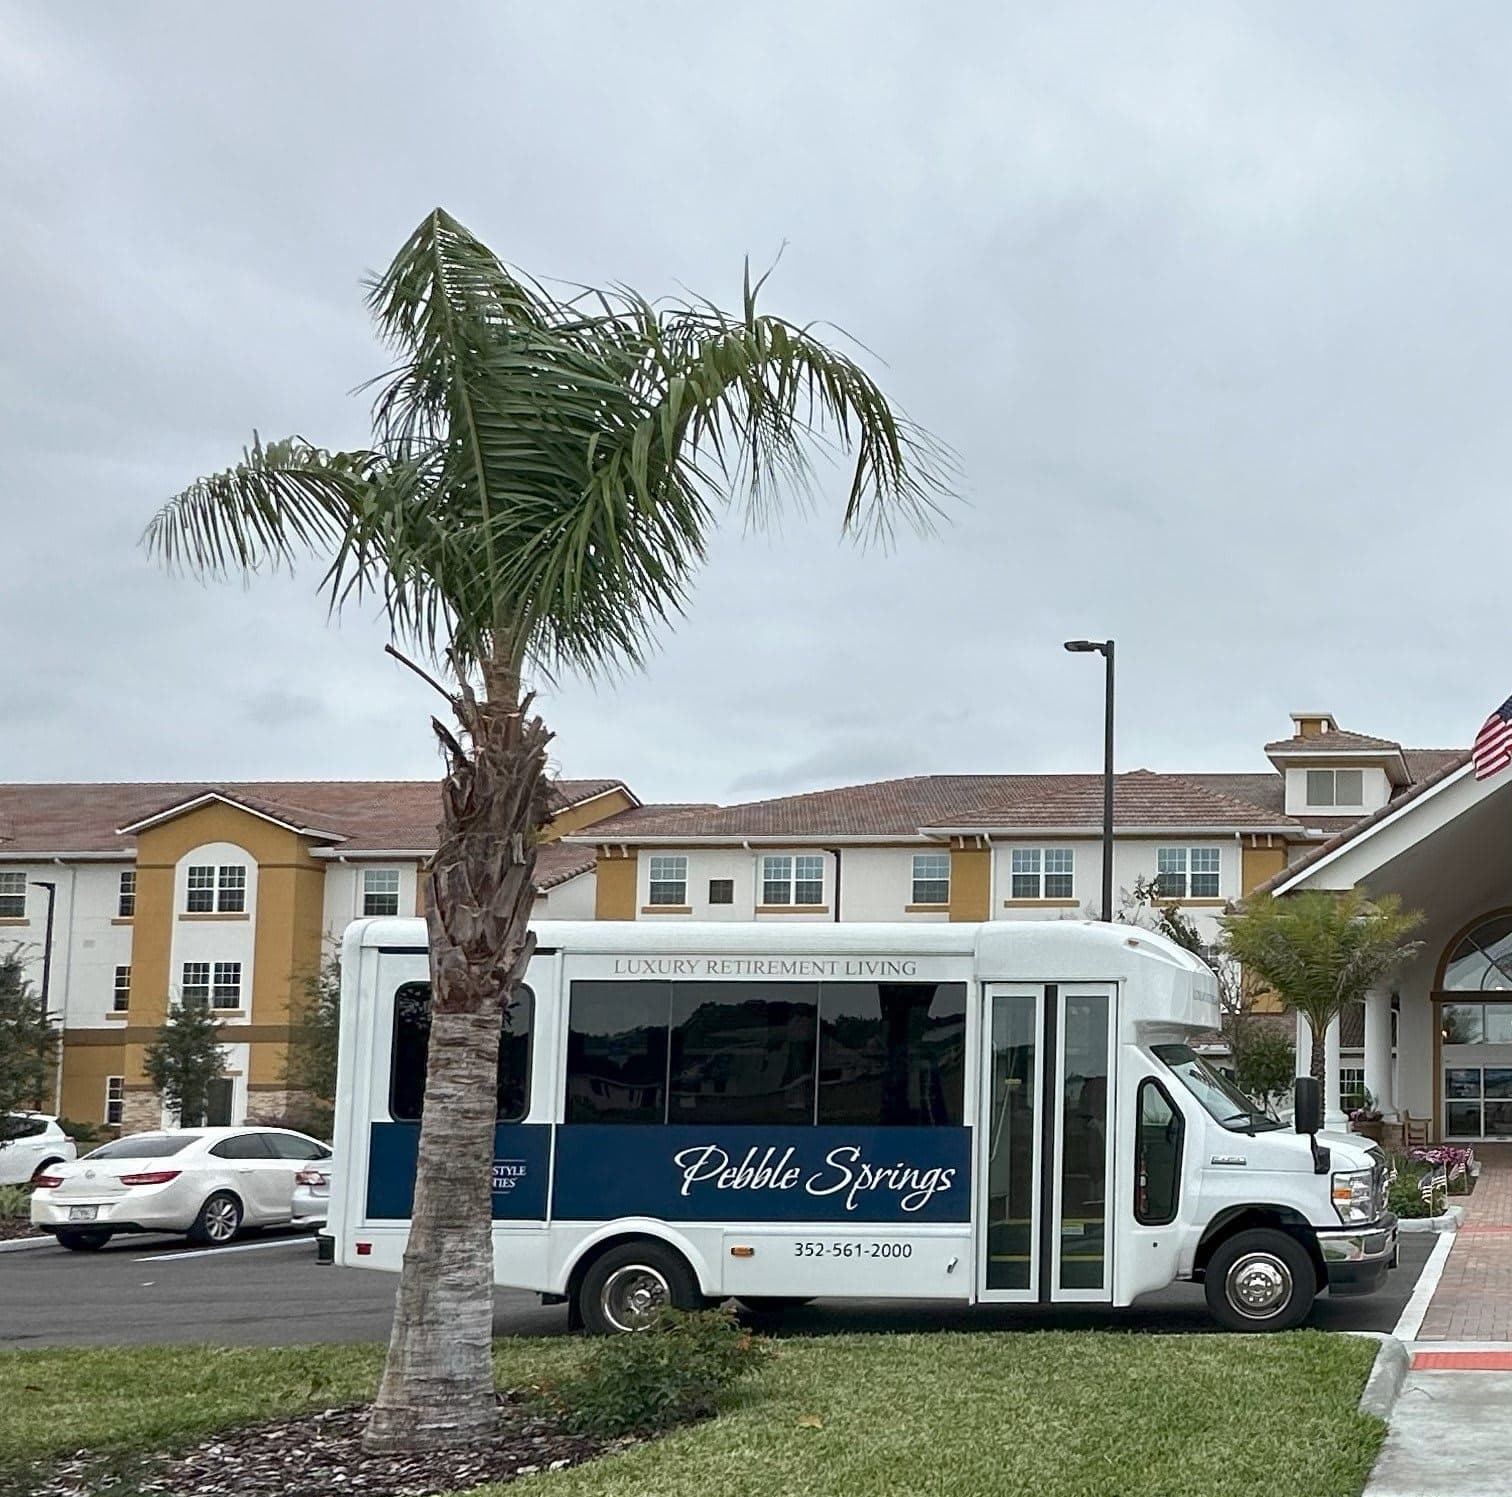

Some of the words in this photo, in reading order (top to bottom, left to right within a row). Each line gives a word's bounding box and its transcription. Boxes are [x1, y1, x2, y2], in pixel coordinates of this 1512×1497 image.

[614, 959, 700, 975] LUXURY
[706, 960, 838, 976] RETIREMENT
[845, 961, 917, 976] LIVING
[673, 1144, 801, 1196] Pebble
[805, 1145, 956, 1212] Springs
[794, 1242, 913, 1258] 352-561-2000
